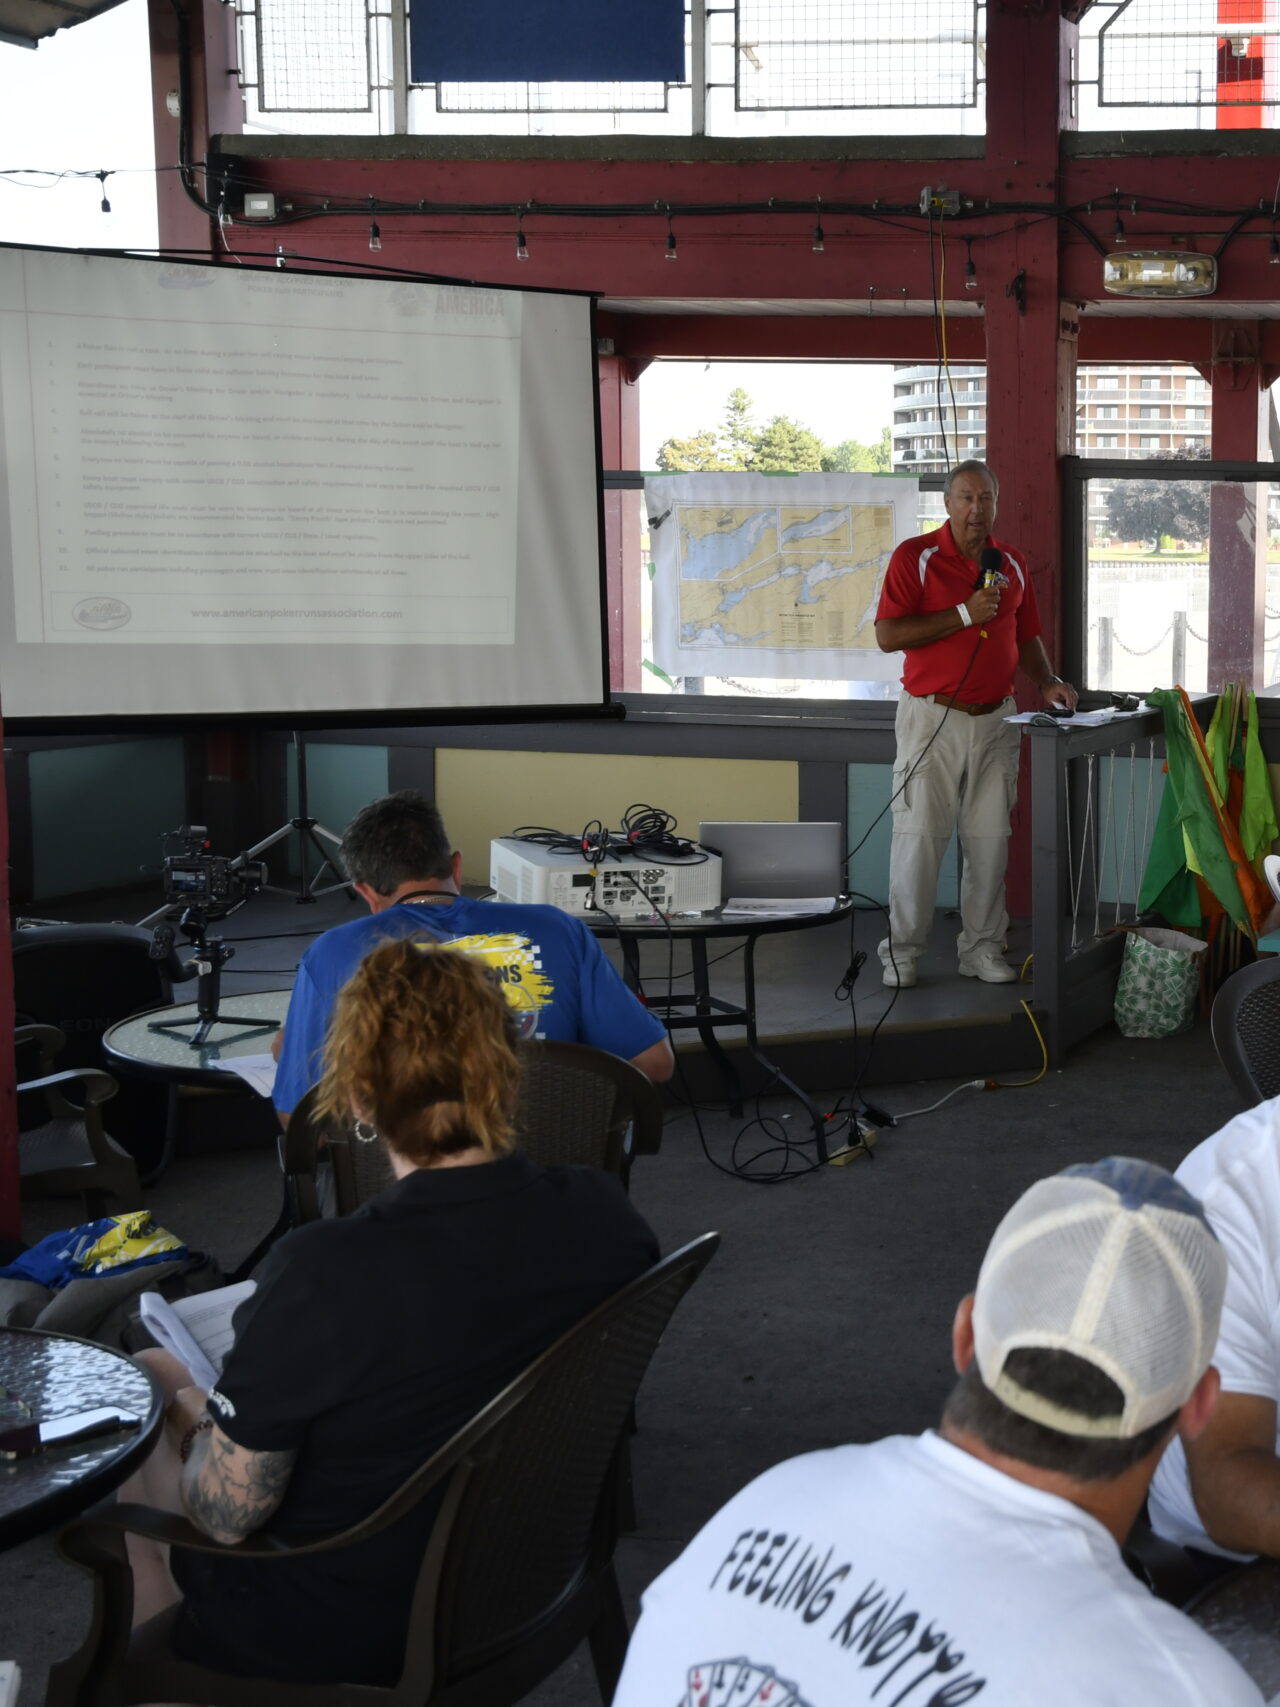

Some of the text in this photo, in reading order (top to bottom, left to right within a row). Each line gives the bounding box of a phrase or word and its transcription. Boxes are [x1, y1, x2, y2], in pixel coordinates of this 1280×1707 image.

[434, 293, 505, 317] AMERICA
[190, 606, 404, 620] www.americanpokerrunsassociation.com
[59, 1017, 111, 1033] EON
[709, 1527, 853, 1625] FEELING
